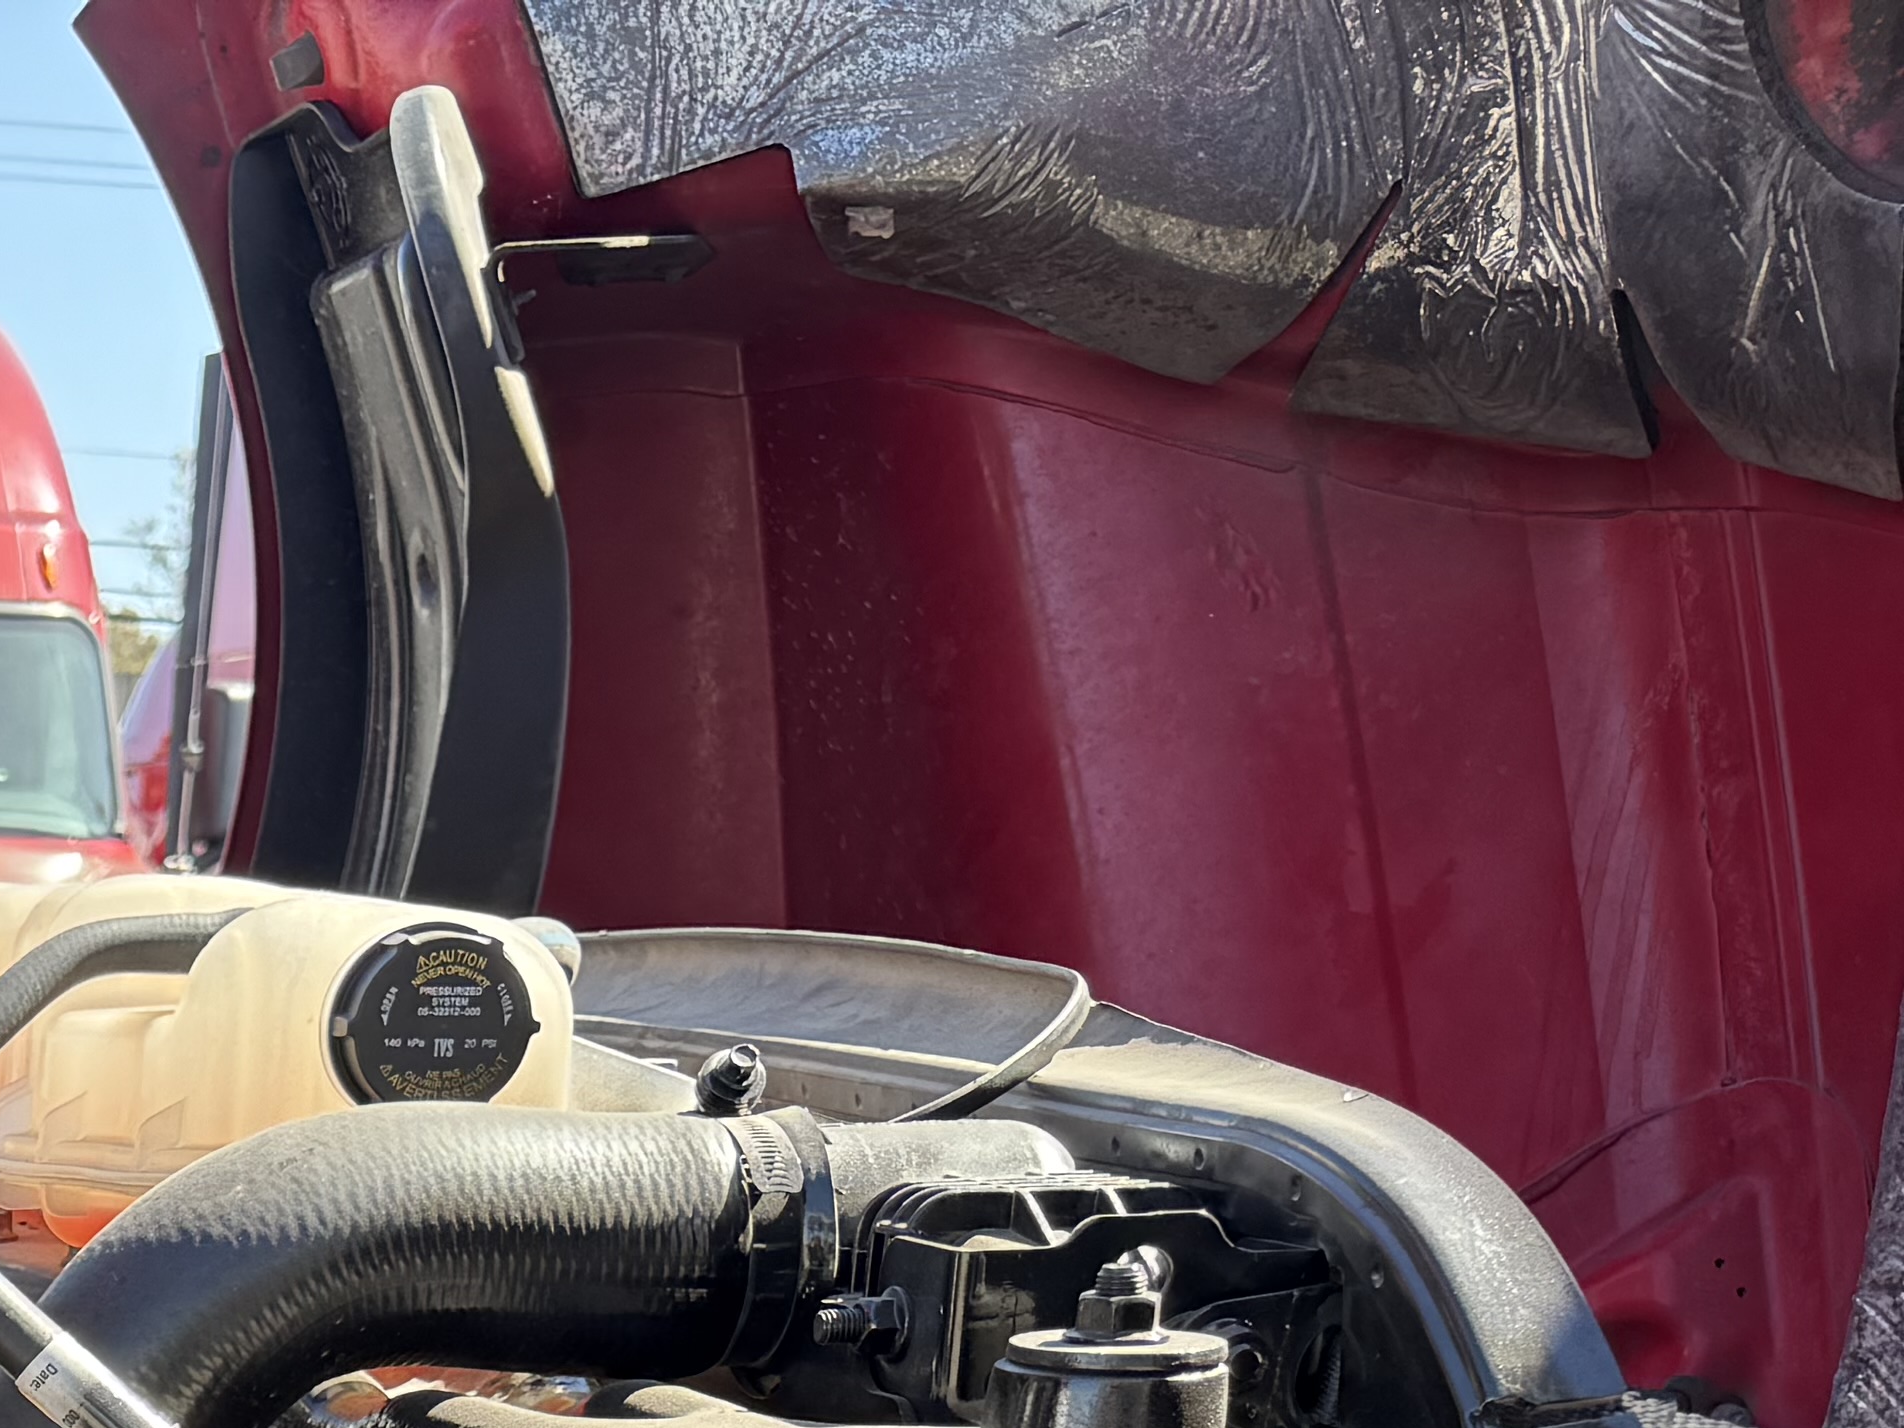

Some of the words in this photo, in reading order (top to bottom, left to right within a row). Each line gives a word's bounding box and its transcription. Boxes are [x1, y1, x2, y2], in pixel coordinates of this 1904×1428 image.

[429, 949, 488, 970] CAUTION
[411, 967, 445, 989] NEVER
[446, 965, 474, 979] OPEN
[471, 971, 492, 989] HOT
[419, 986, 483, 996] PRESSURIZED
[432, 997, 469, 1007] SYSTEM
[407, 1038, 425, 1048] kPa
[433, 1038, 454, 1058] TVS
[464, 1038, 477, 1048] 20
[481, 1039, 497, 1048] PSI
[388, 1053, 509, 1100] AVERTISSEMENT
[404, 1070, 443, 1090] OUVRIR
[451, 1063, 485, 1087] CHAUD
